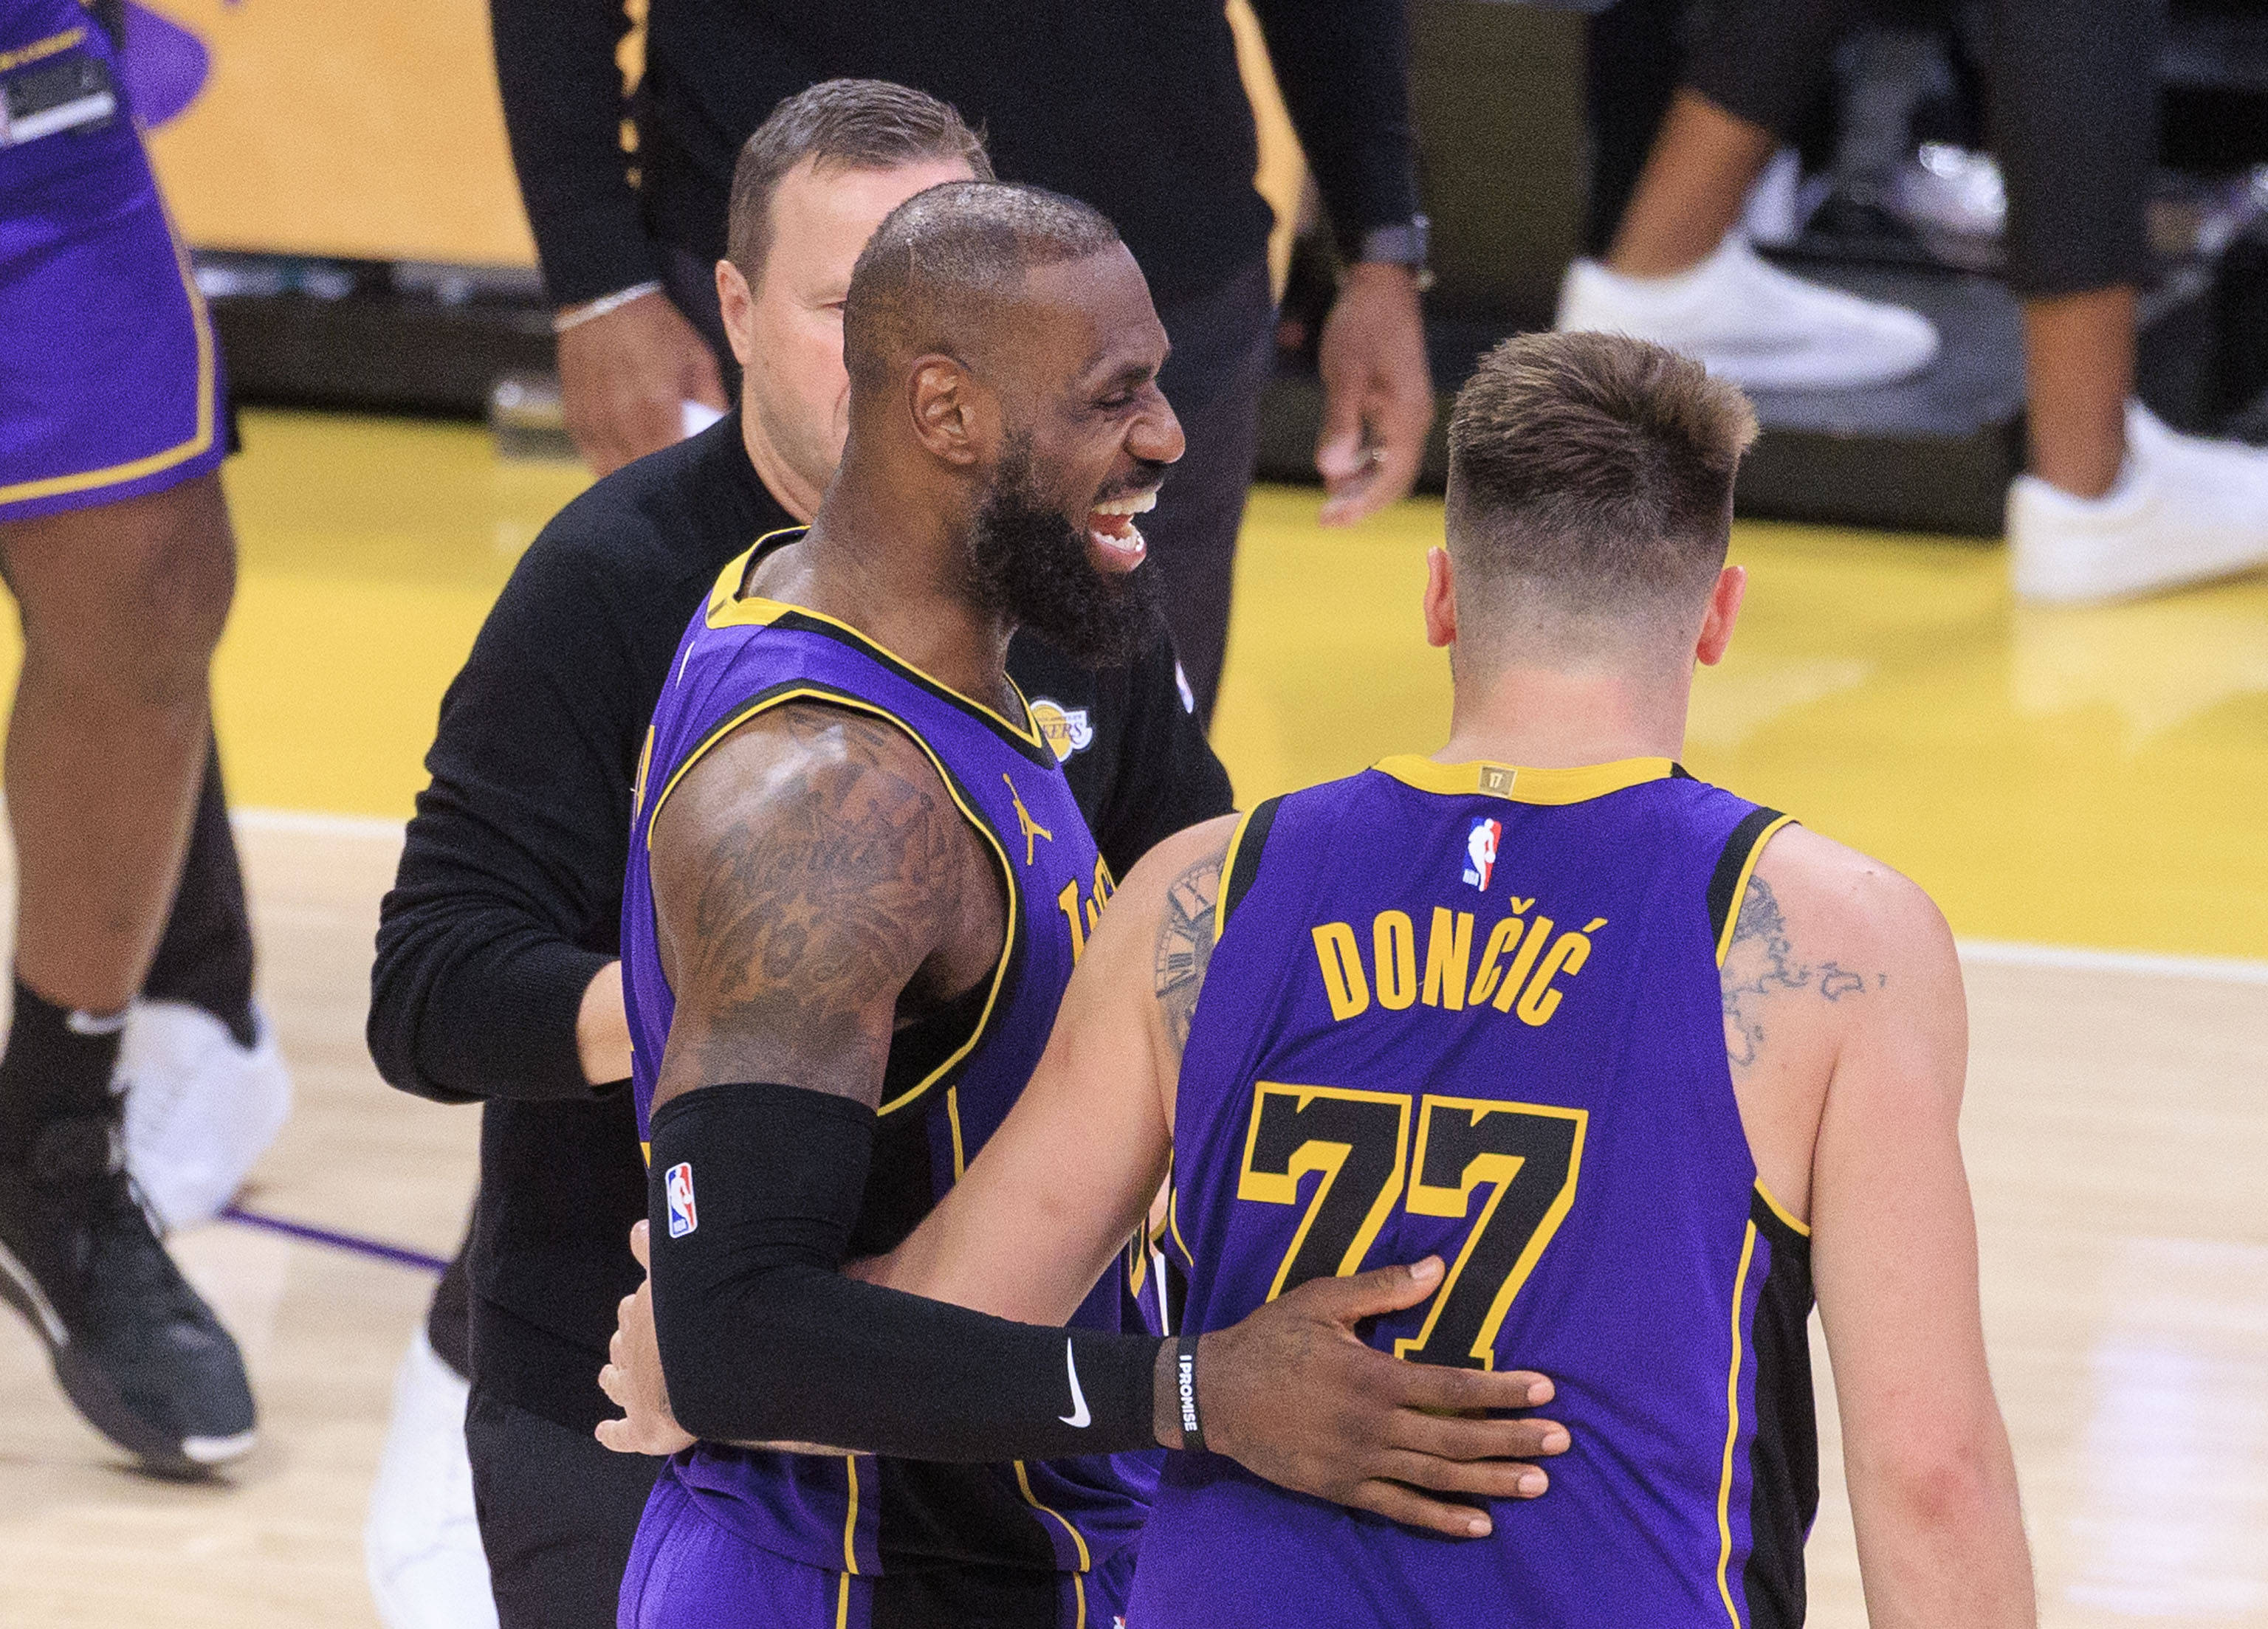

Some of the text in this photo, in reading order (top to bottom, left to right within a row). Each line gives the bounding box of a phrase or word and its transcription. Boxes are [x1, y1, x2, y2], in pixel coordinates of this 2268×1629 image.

[1490, 772, 1503, 788] 17
[1310, 896, 1608, 1027] DONČIĆ
[1237, 1081, 1588, 1371] 77
[1179, 1362, 1197, 1432] PROMISE
